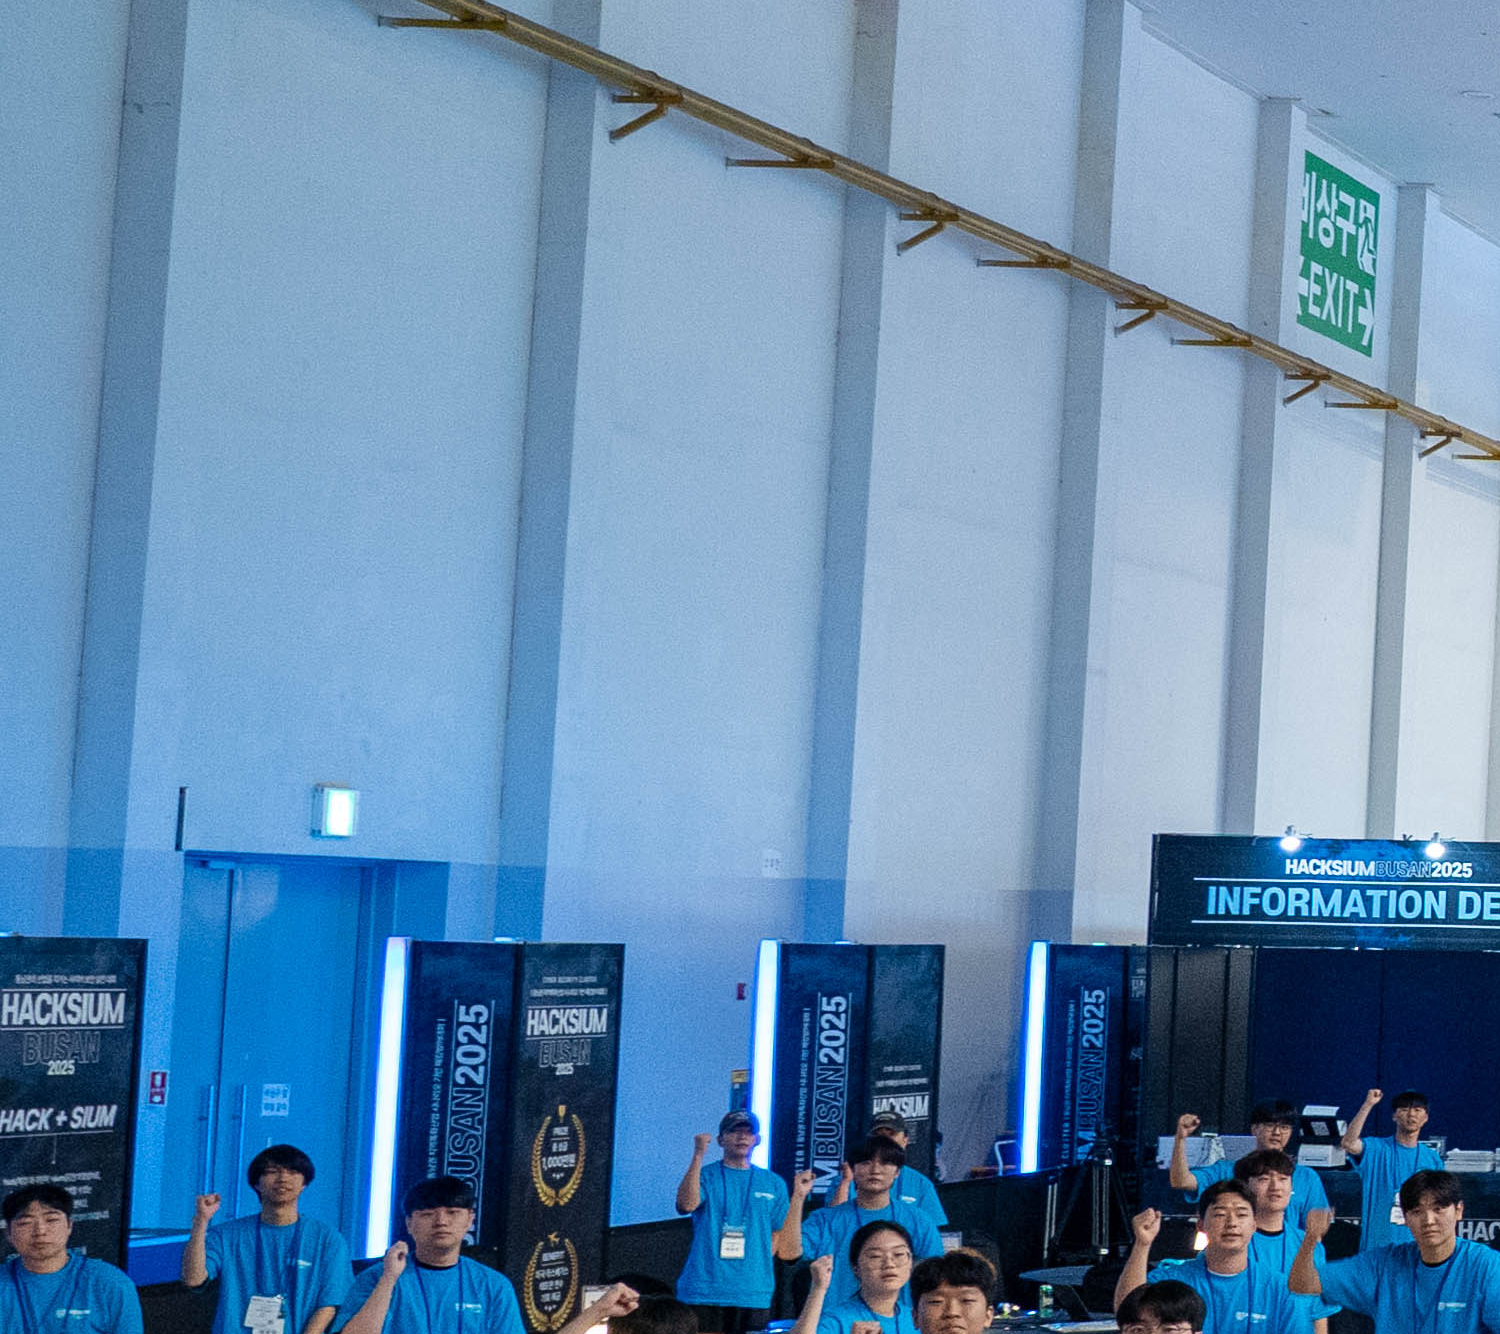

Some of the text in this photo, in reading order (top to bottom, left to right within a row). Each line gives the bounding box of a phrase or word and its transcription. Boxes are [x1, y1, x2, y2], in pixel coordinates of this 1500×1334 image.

[1309, 264, 1359, 333] EXIT
[1207, 885, 1447, 920] INFORMATION
[1, 993, 126, 1025] HACKSIUM
[526, 1008, 609, 1036] HACKSIUM
[22, 1031, 101, 1065] BUSAN
[539, 1039, 592, 1067] BUSAN
[47, 1060, 75, 1075] 2025
[0, 1105, 118, 1132] HACK SIUM
